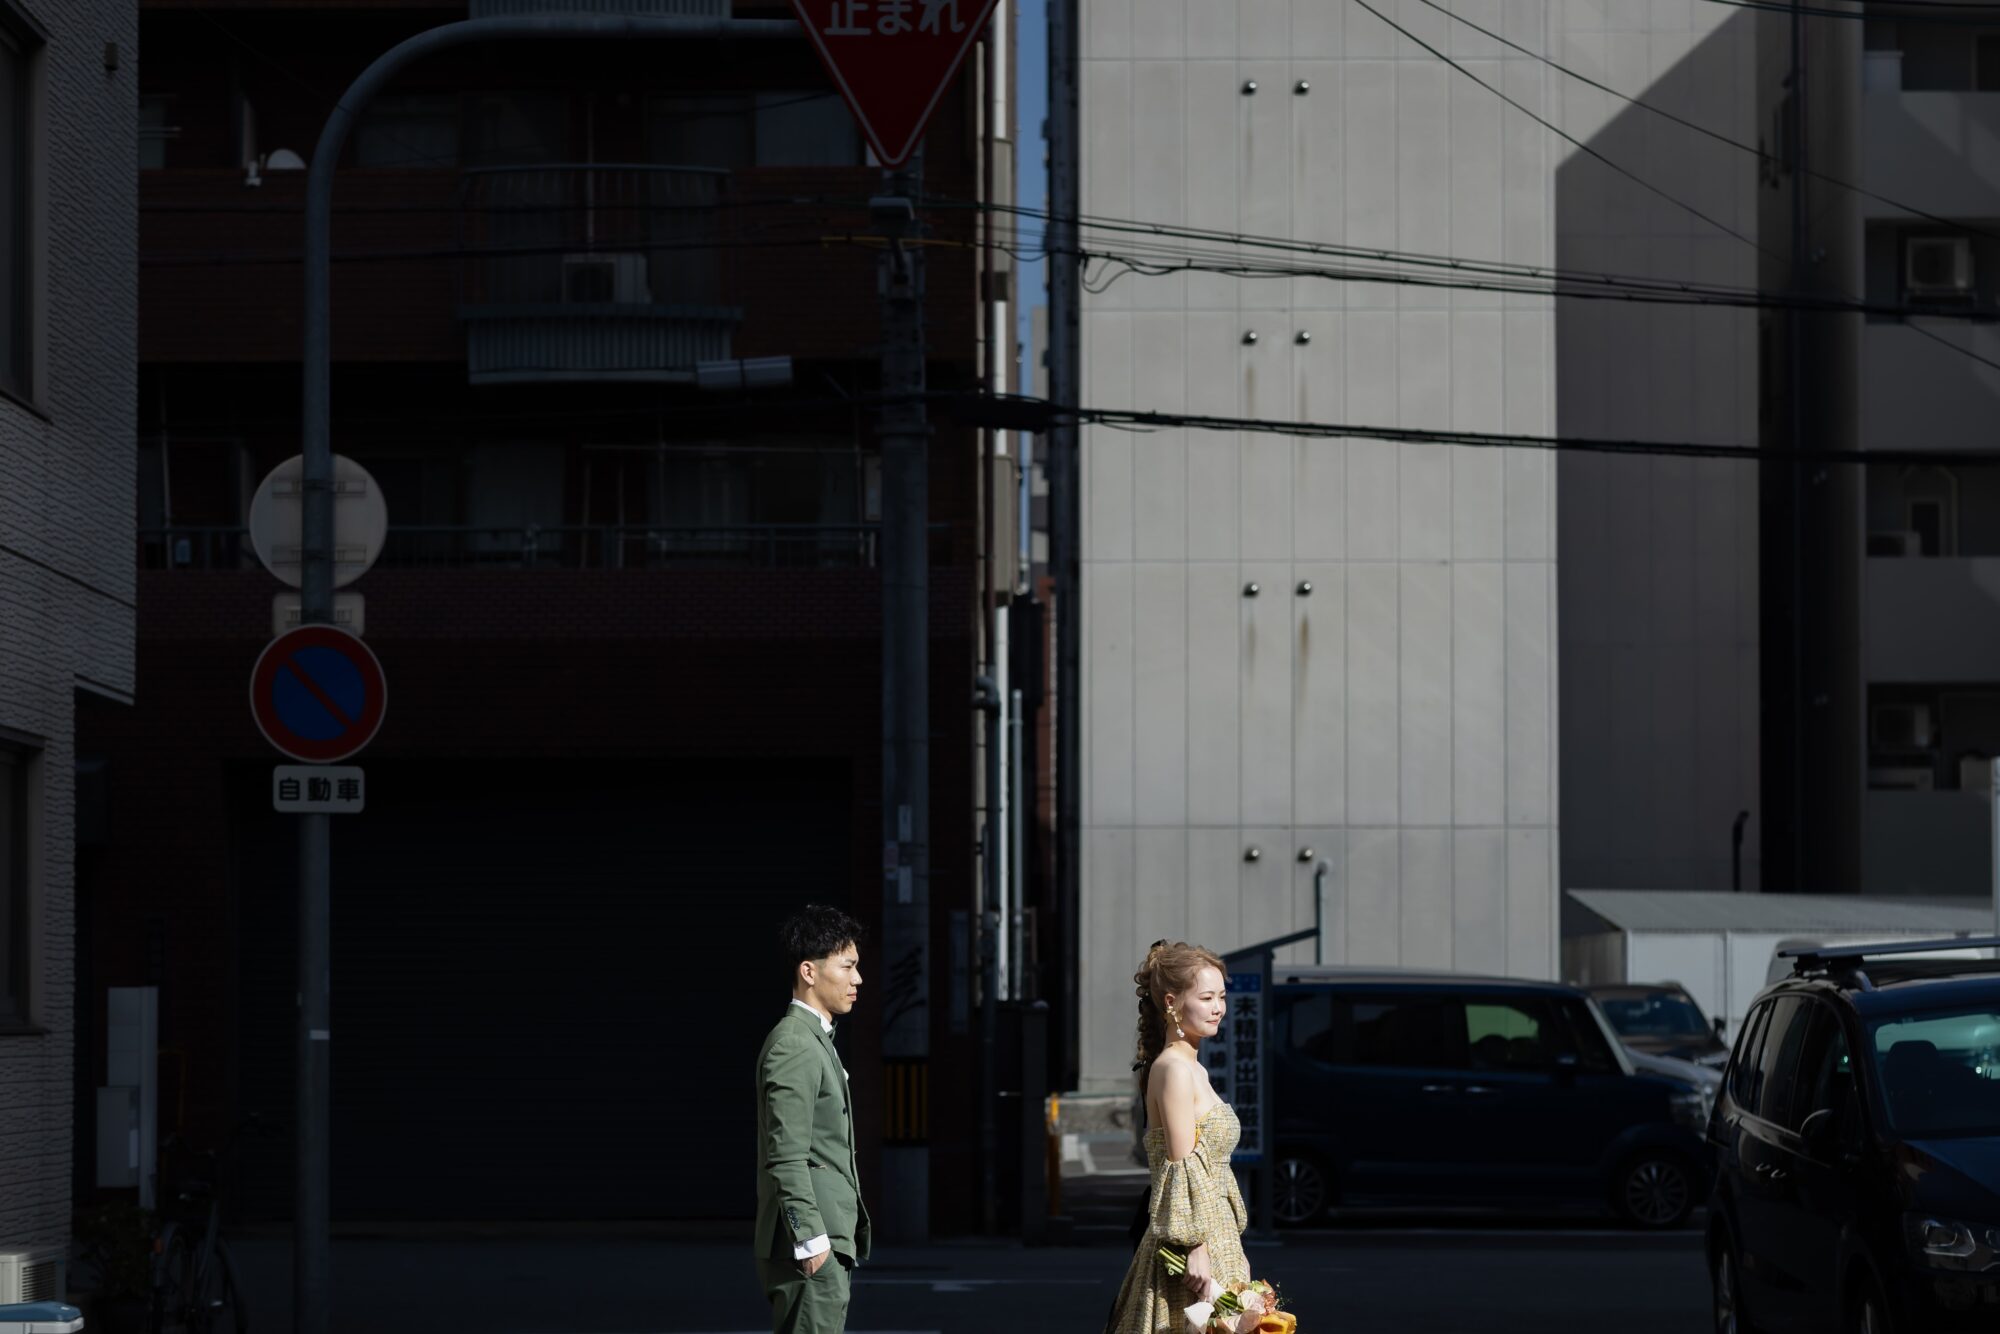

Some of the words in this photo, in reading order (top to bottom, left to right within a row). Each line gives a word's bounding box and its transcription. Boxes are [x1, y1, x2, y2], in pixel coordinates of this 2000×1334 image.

[823, 0, 966, 36] 止まれ
[279, 776, 361, 802] 自動車
